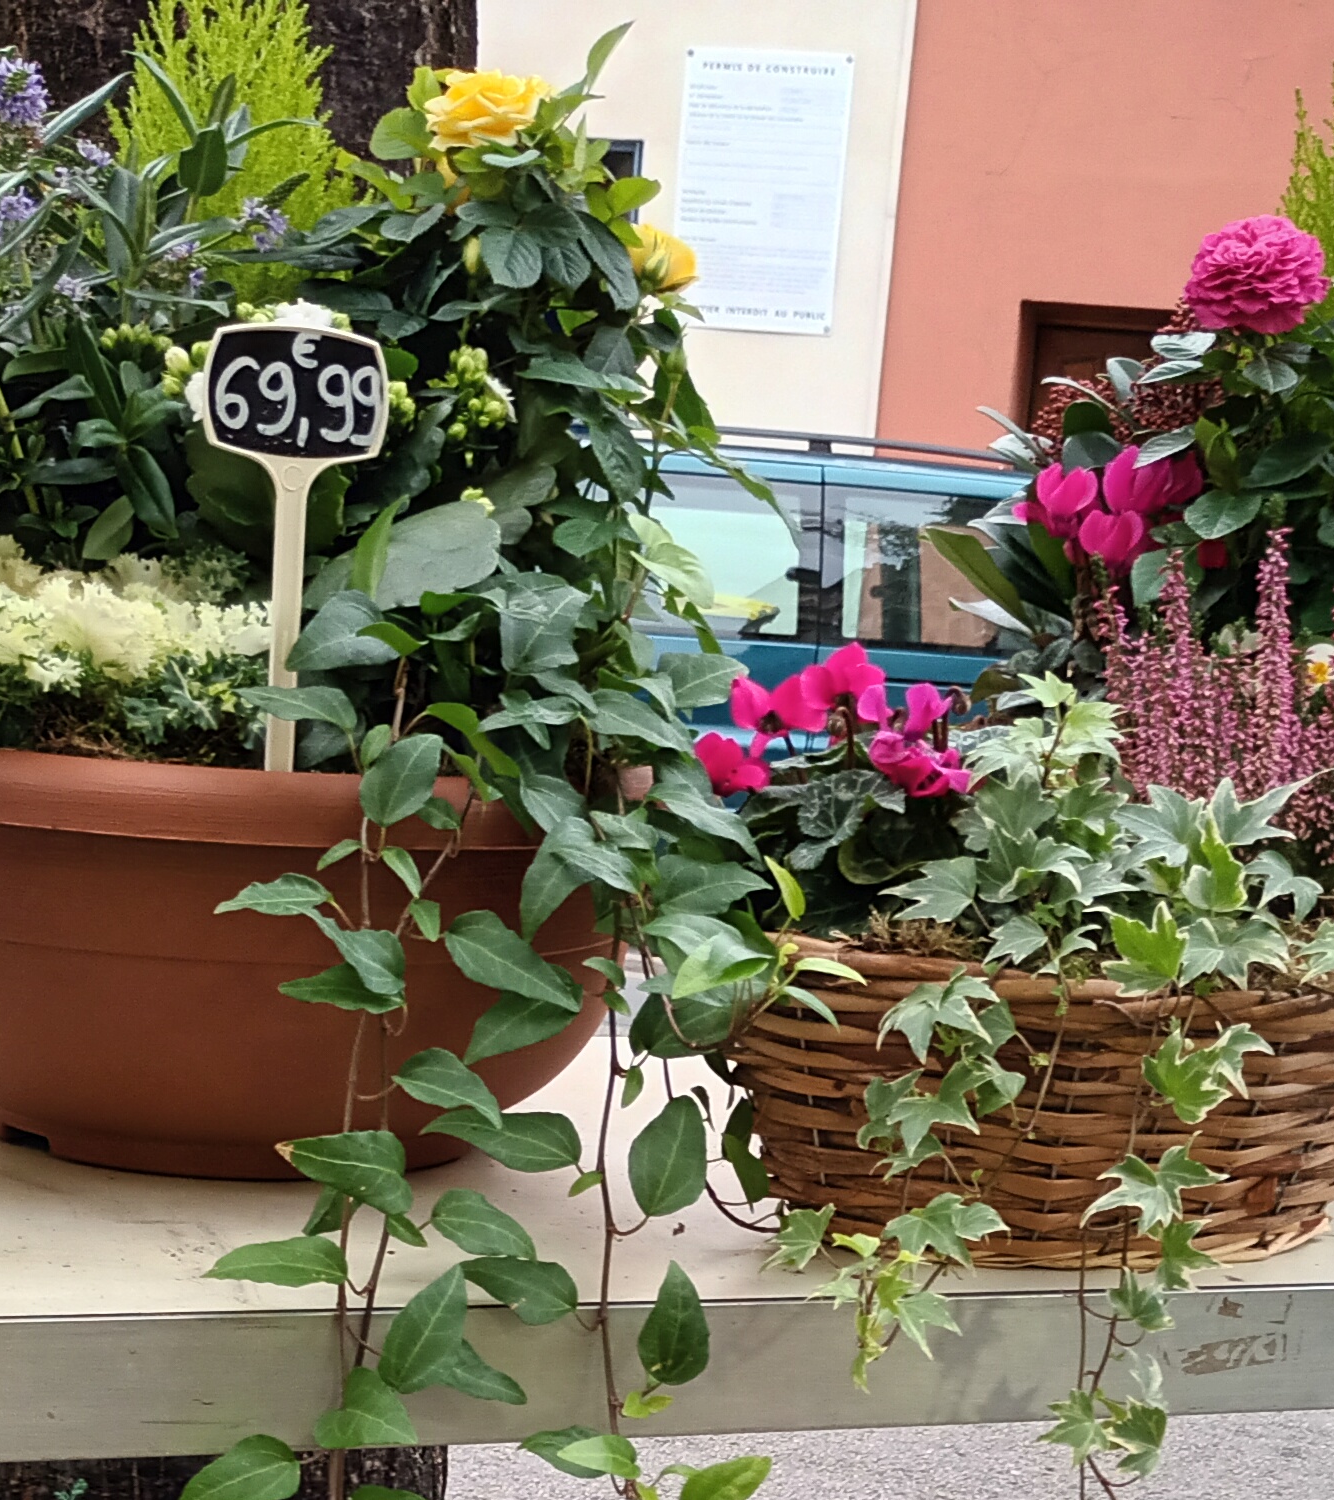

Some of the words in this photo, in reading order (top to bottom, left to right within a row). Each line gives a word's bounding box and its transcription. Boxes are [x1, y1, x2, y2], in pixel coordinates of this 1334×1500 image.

[702, 60, 743, 72] PERMIS
[747, 62, 761, 73] DE
[765, 63, 836, 77] CONSTRUIRE
[725, 306, 768, 317] INTERDIT
[774, 309, 788, 319] AU
[793, 311, 826, 321] PUBLIC
